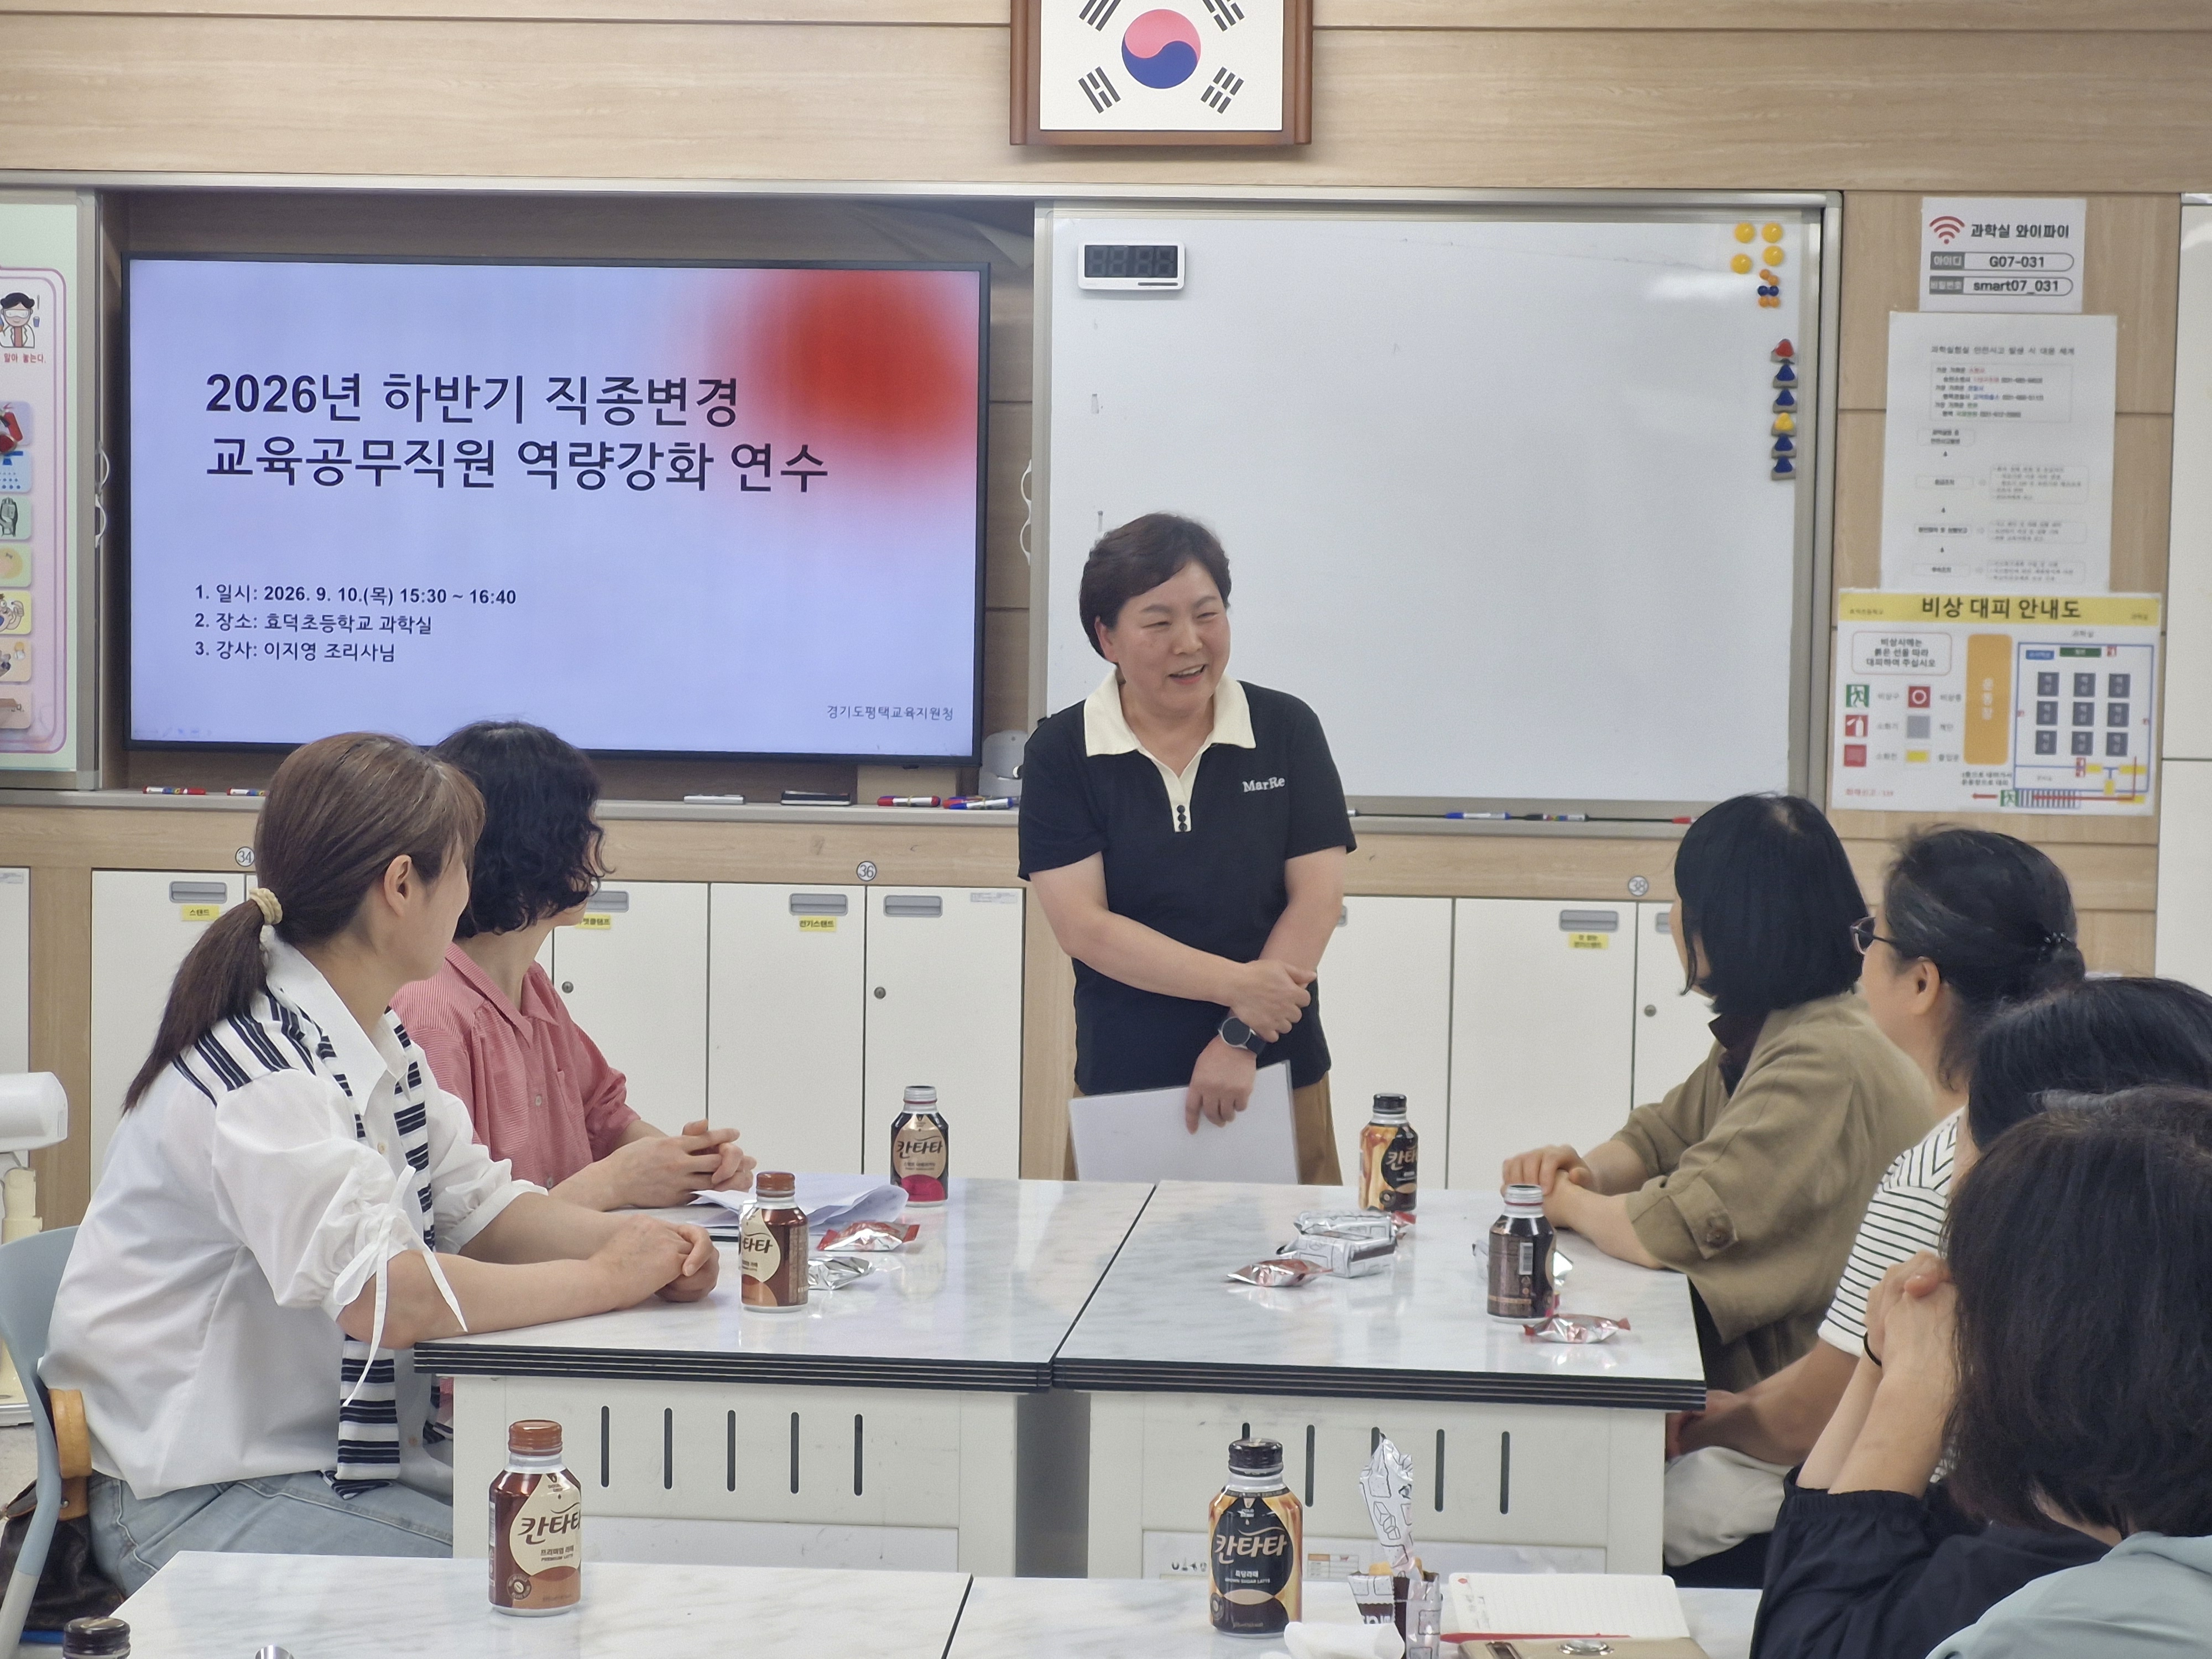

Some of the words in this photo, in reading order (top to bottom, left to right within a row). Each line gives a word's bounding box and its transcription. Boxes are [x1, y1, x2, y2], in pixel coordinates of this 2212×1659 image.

[1971, 223, 2010, 238] 과학실
[2016, 224, 2069, 238] 와이파이
[1989, 255, 2045, 268] G07-031
[1973, 280, 2059, 294] smart07_031
[206, 373, 361, 421] 2026년
[383, 374, 523, 424] 하반기
[545, 376, 737, 427] 직종변경
[206, 436, 495, 488] 교육공무직원
[518, 441, 714, 492] 역량강화
[731, 443, 828, 493] 연수
[195, 585, 210, 600] 1.
[216, 584, 258, 603] 일시:
[264, 586, 311, 602] 2026.
[316, 587, 331, 602] 9.
[338, 587, 394, 606] 10.(목)
[400, 588, 447, 604] 15:30
[469, 589, 517, 605] 16:40
[1922, 597, 1963, 618] 비상
[1970, 598, 2010, 619] 대피
[2018, 598, 2081, 620] 안내도
[195, 613, 210, 628] 2.
[216, 612, 258, 630] 장소:
[264, 613, 373, 633] 효덕초등학교
[379, 614, 432, 635] 과학실
[195, 641, 210, 656] 3.
[216, 640, 258, 659] 강사:
[264, 642, 317, 661] 이지영
[324, 643, 395, 662] 조리사님
[827, 705, 954, 721] 경기도평택교육지원청
[238, 851, 252, 863] 34
[859, 864, 875, 878] 36
[1630, 879, 1646, 892] 38
[799, 919, 834, 928] 전기스탠드
[896, 1140, 943, 1159] 칸타타
[1386, 1150, 1417, 1171] 칸타
[742, 1237, 773, 1254] 타타
[540, 1547, 564, 1556] 프리미엄
[1214, 1533, 1288, 1564] 칸타타
